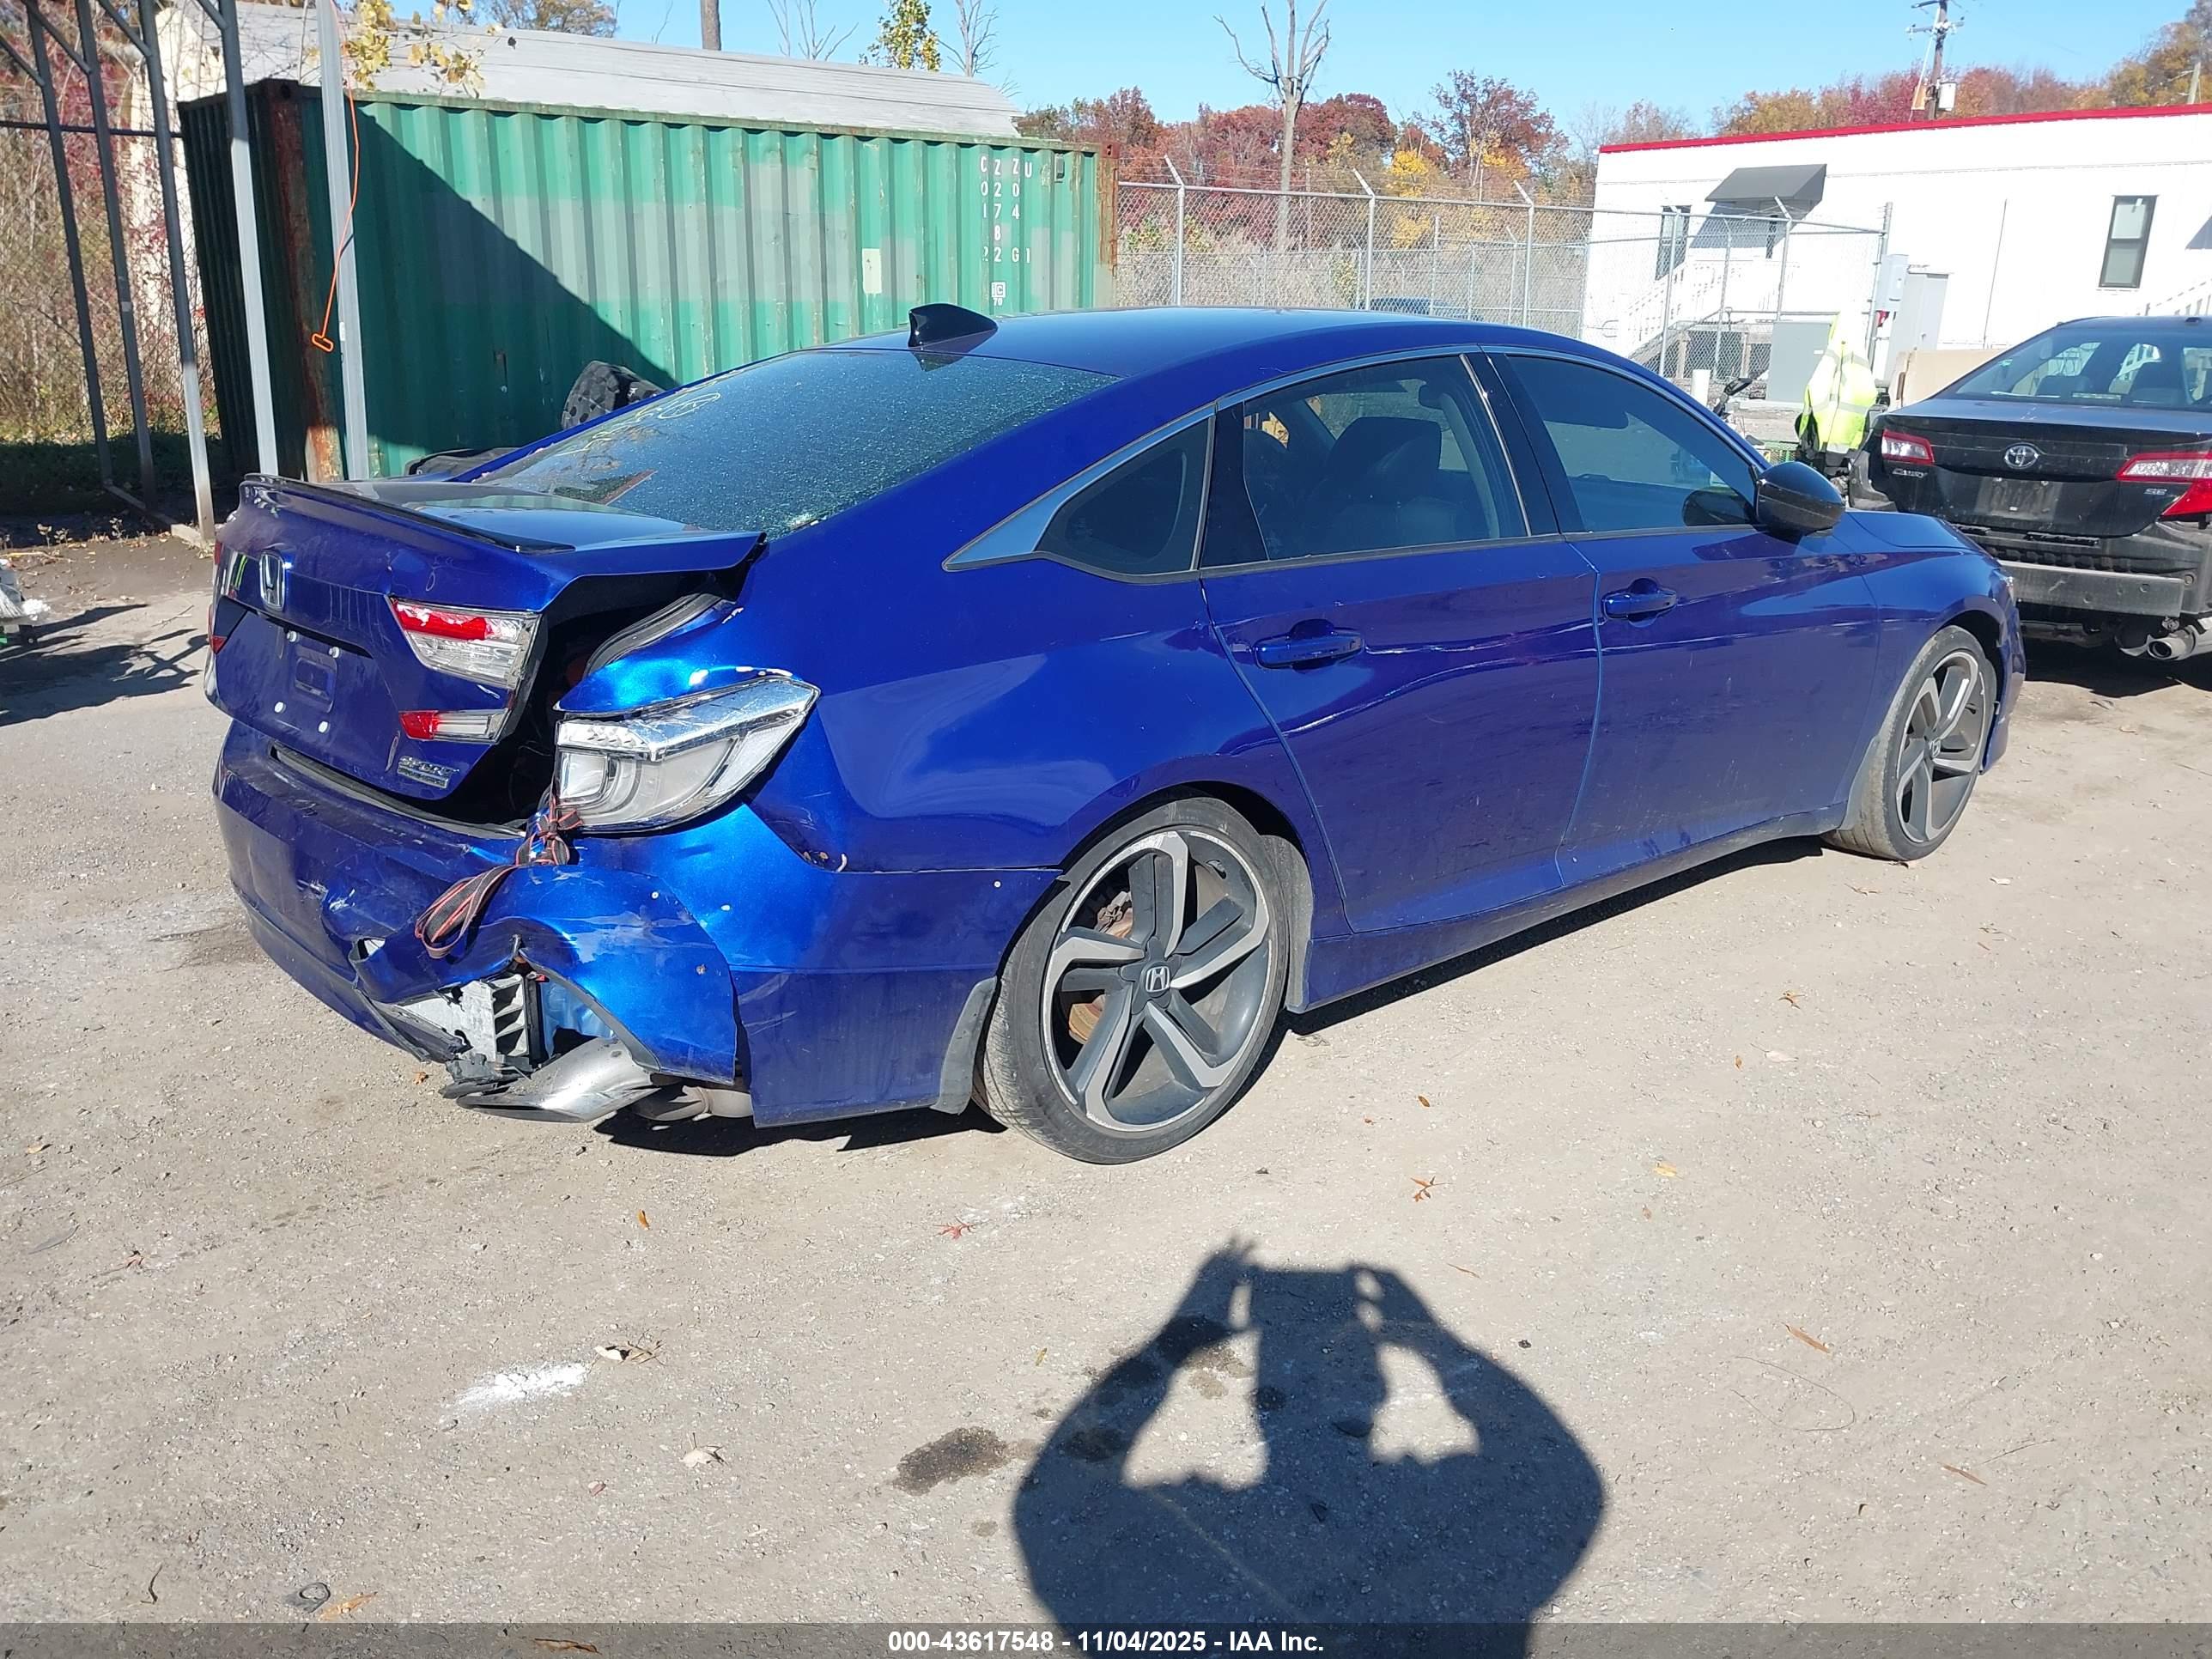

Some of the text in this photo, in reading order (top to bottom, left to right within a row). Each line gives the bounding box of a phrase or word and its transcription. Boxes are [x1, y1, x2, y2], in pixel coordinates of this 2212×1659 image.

[980, 155, 1032, 178] CZZU
[981, 181, 1020, 197] 020
[983, 203, 1020, 219] 174
[994, 225, 1001, 240] 8
